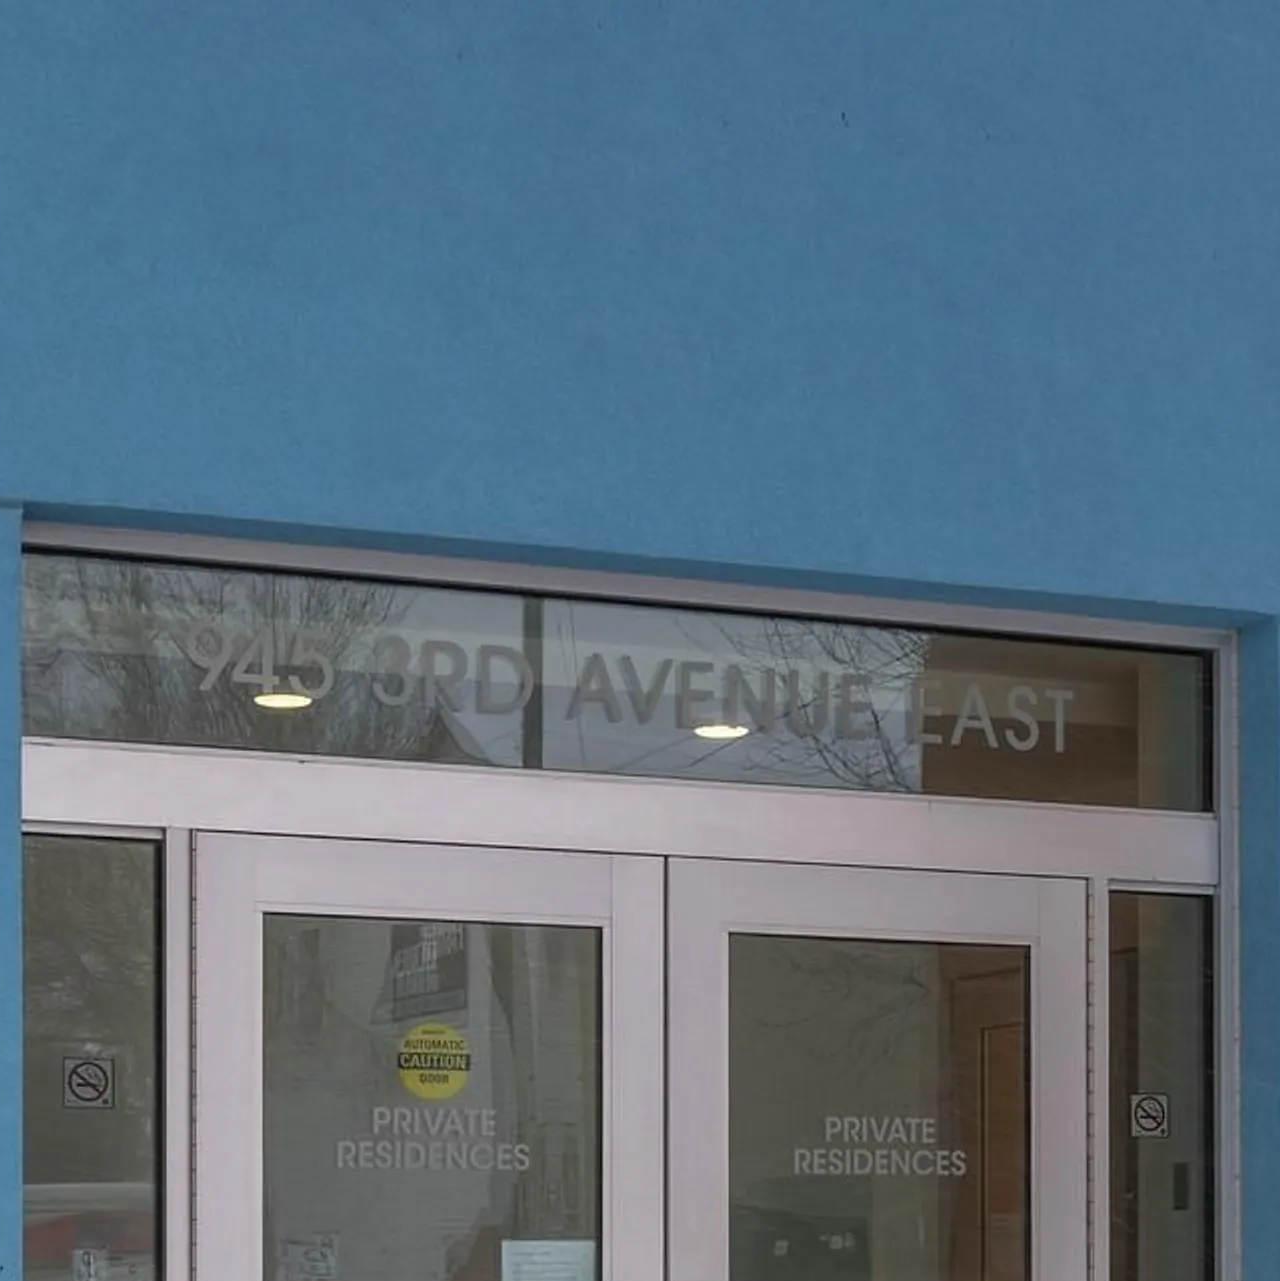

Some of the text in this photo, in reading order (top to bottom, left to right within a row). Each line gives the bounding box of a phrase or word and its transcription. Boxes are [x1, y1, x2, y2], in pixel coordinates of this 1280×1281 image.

[185, 618, 1075, 754] 945 3RD AVENUE EAST
[403, 1039, 465, 1052] AUTOMATIC
[399, 1053, 467, 1070] CAUTION
[419, 1072, 450, 1085] DOOR
[371, 1106, 497, 1137] PRIVATE
[824, 1115, 937, 1144] PRIVATE
[336, 1140, 531, 1172] RESIDENCES
[793, 1148, 967, 1177] RESIDENCES
